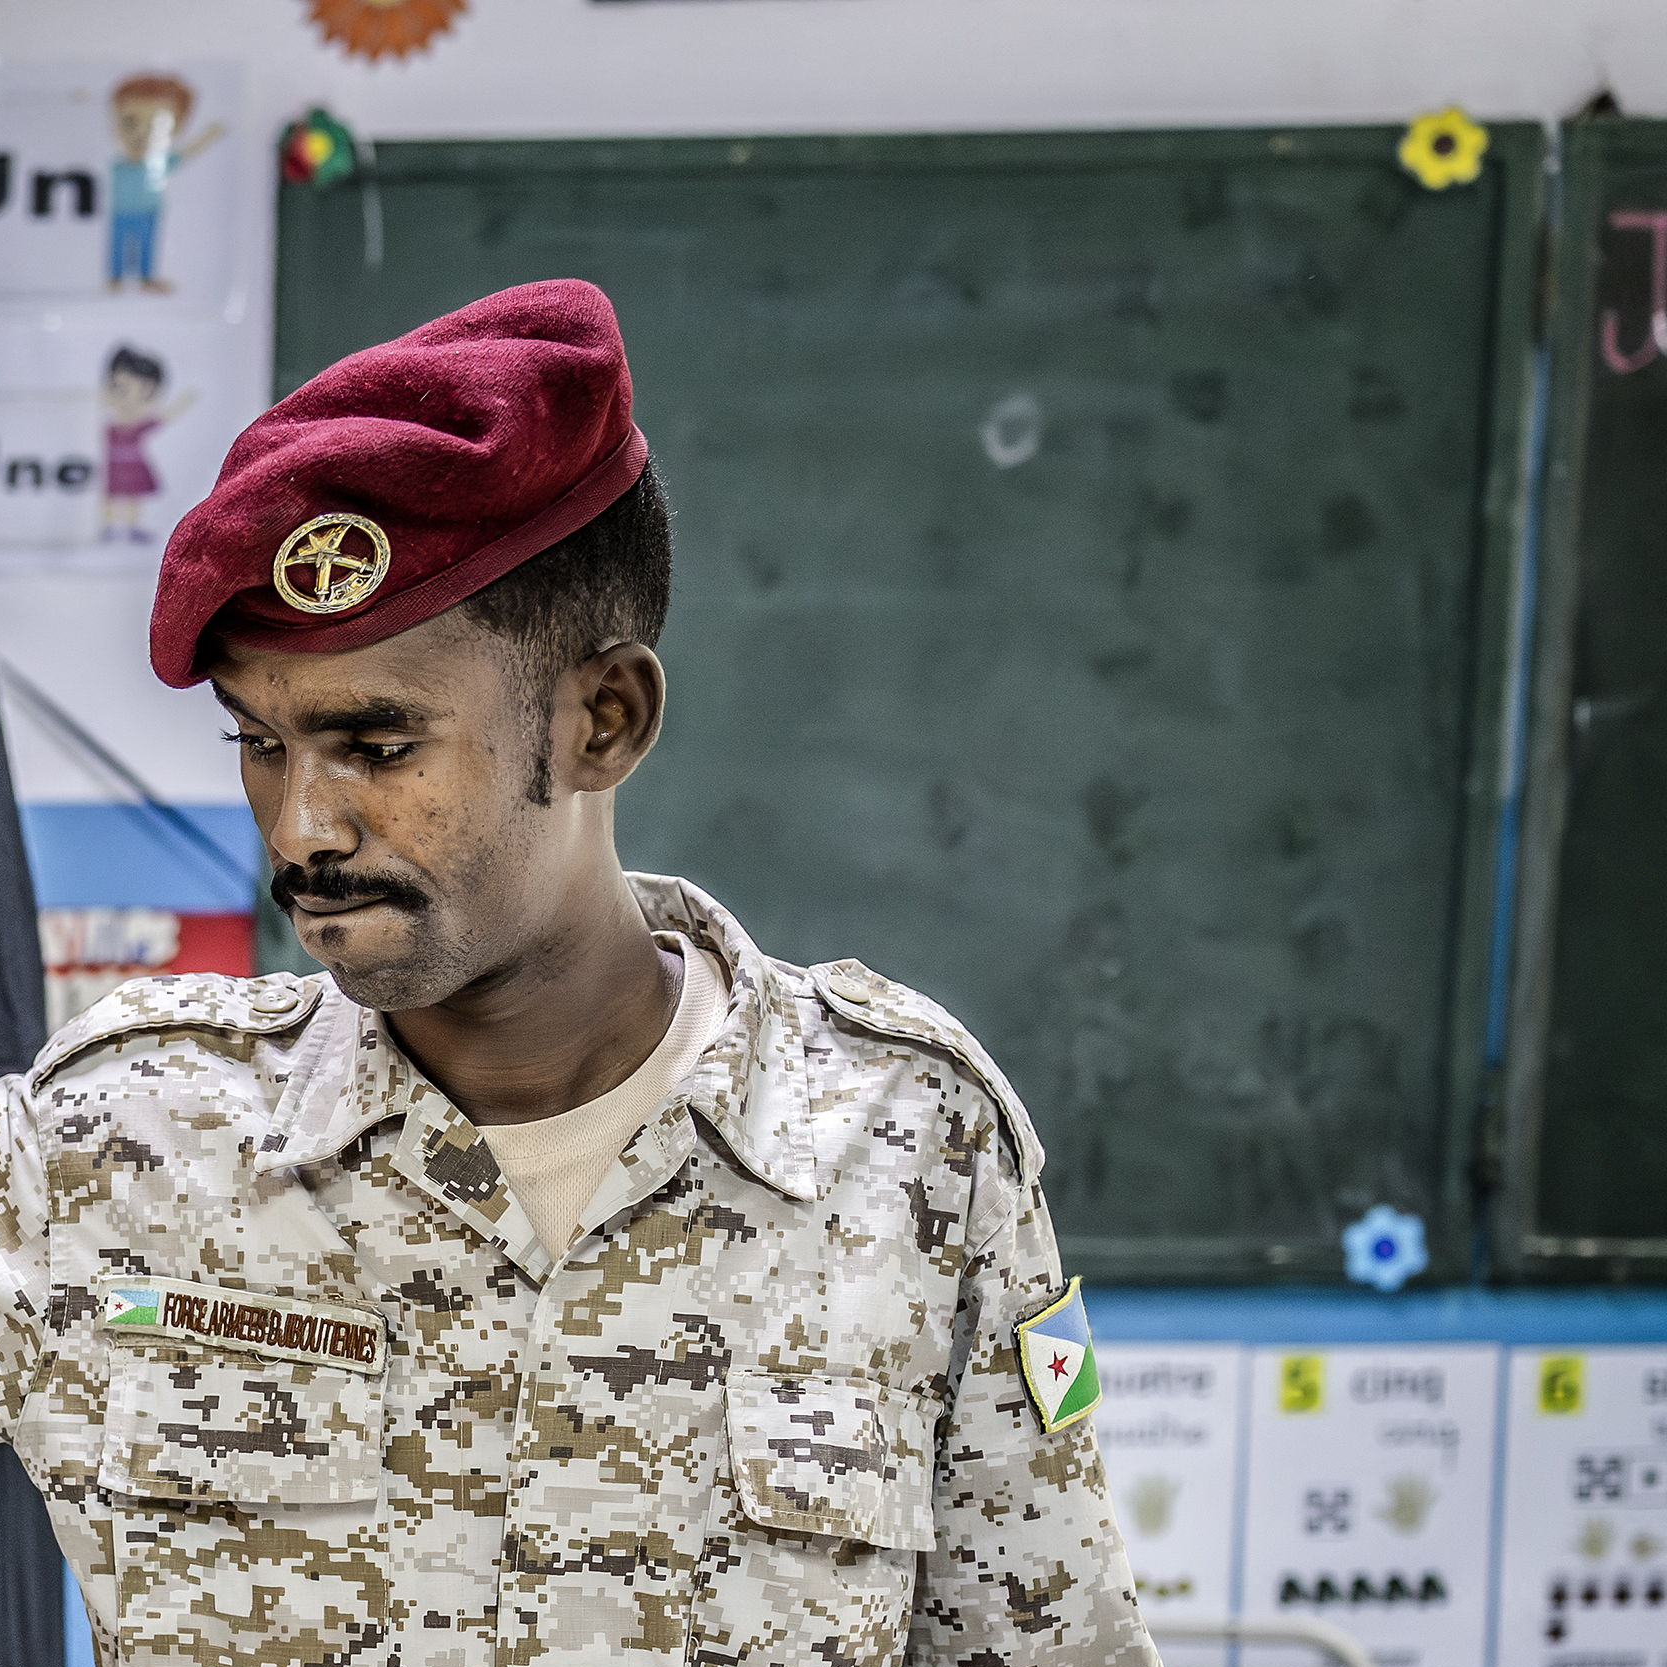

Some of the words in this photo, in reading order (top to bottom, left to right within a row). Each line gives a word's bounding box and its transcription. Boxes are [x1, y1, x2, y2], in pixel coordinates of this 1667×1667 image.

[163, 1291, 207, 1334] FORCE
[1282, 1356, 1318, 1411] 5
[1543, 1366, 1581, 1411] 6
